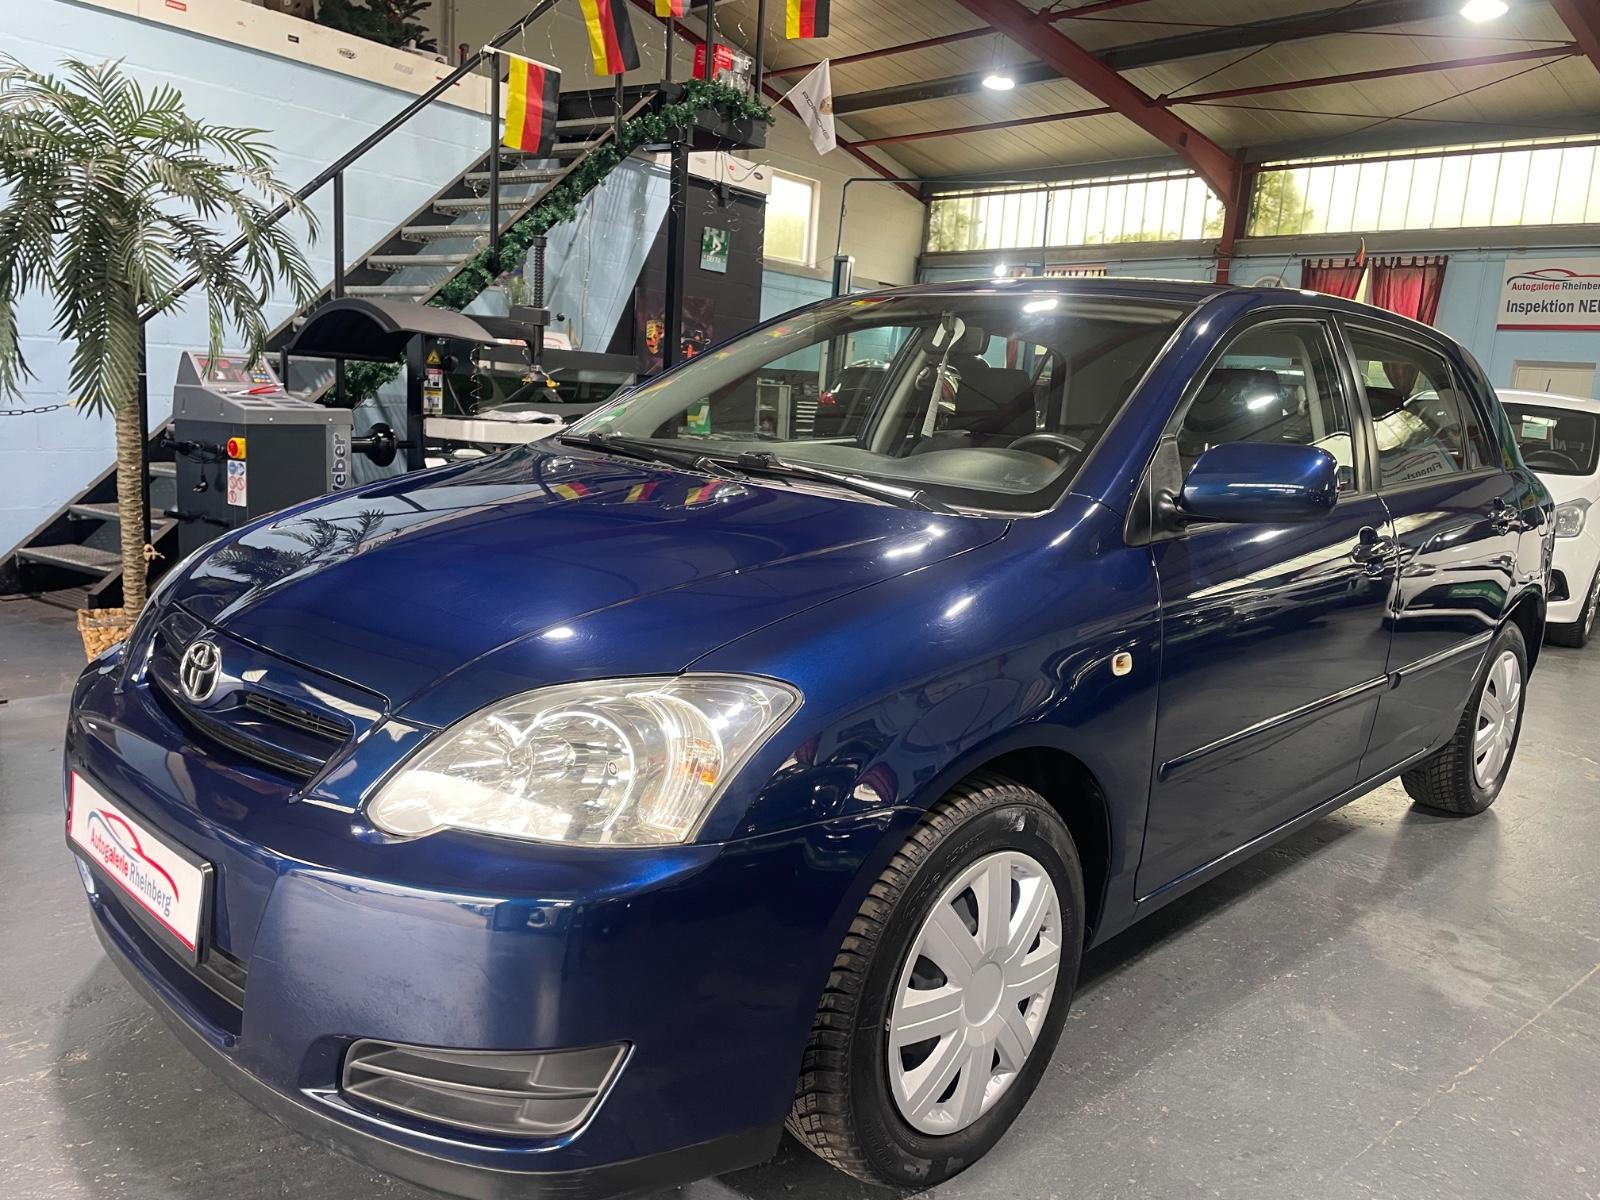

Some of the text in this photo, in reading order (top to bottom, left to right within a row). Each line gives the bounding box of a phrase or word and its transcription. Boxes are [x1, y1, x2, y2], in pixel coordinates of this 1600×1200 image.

[802, 91, 831, 140] PORCHE
[1511, 282, 1560, 292] Autogalerie
[1506, 299, 1574, 315] Inspektion
[90, 828, 172, 918] Autogalerie Rheinberg
